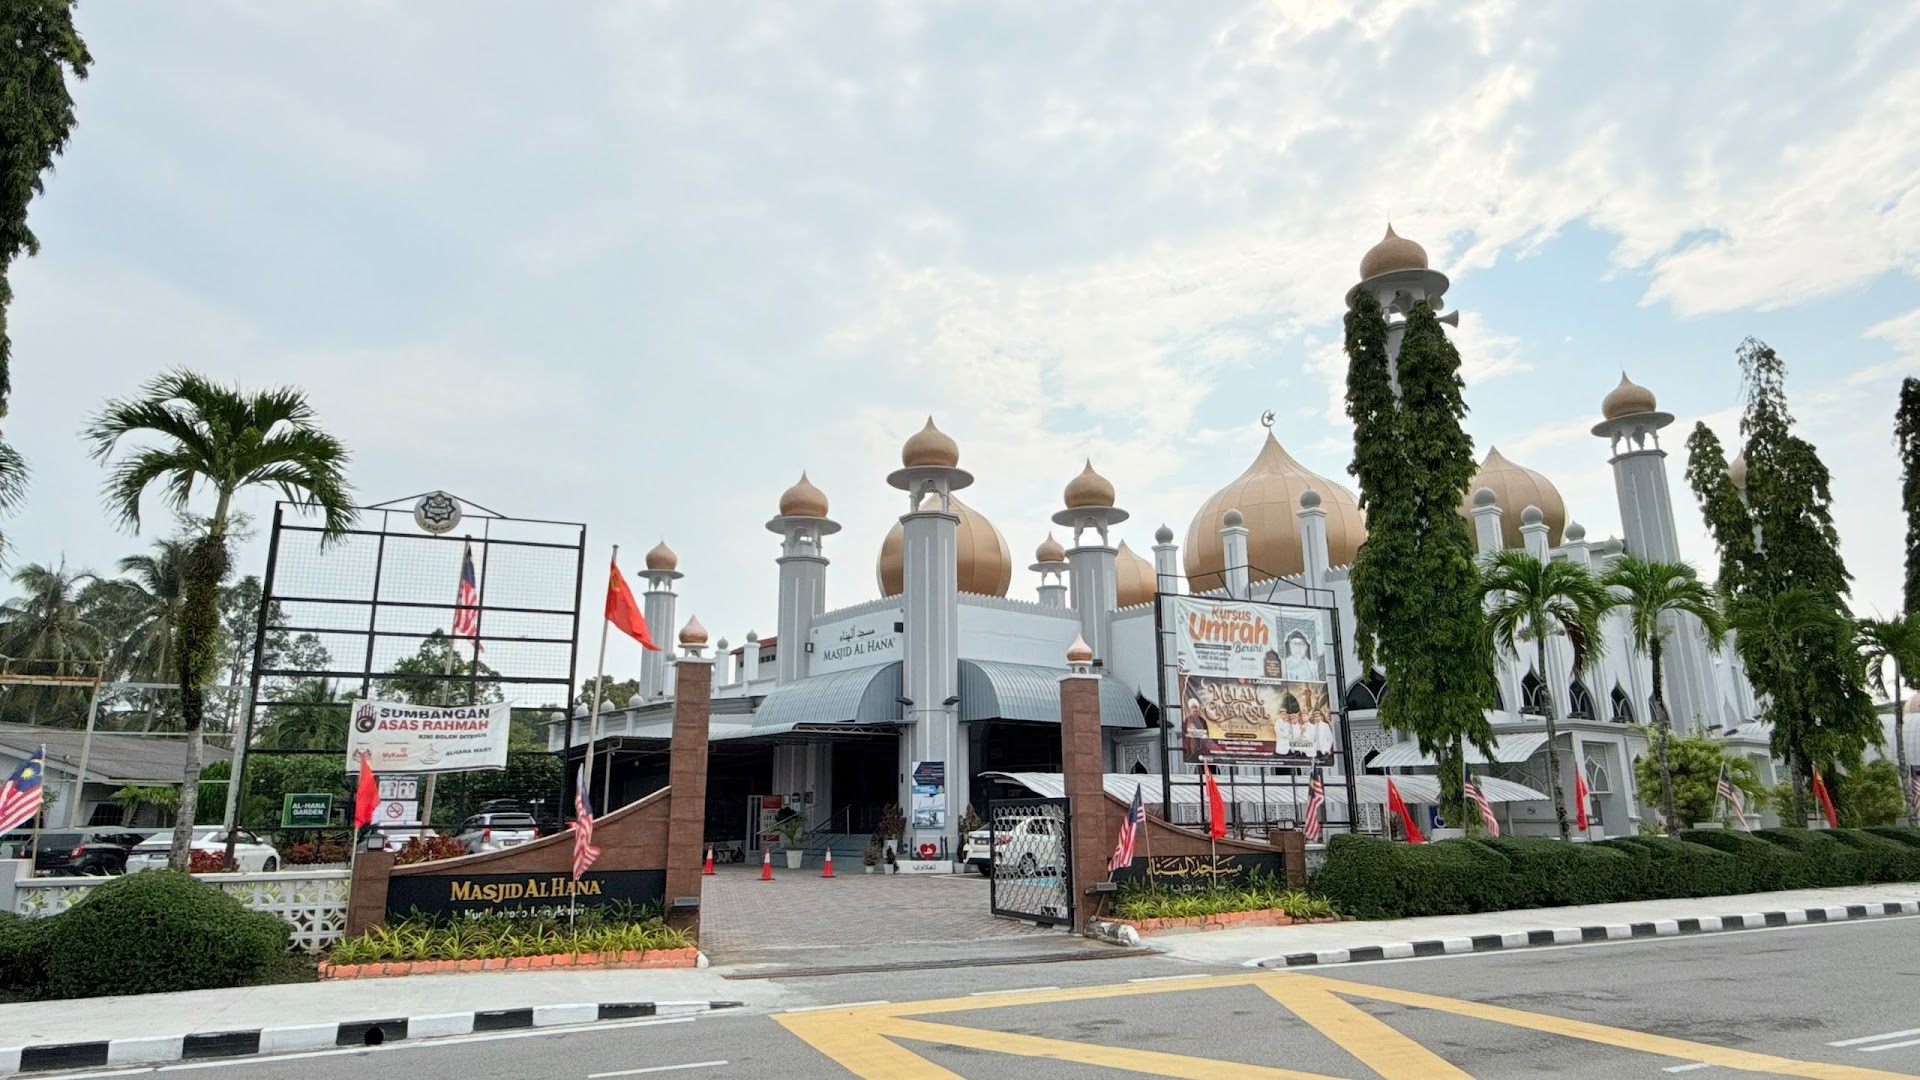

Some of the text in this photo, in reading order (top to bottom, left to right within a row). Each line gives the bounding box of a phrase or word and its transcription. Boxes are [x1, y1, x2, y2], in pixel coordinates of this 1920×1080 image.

[1212, 606, 1251, 621] Kursus
[1189, 612, 1269, 645] Umrah
[823, 646, 852, 661] MASJID
[854, 644, 864, 655] AL
[380, 708, 490, 719] SUMBANGAN
[378, 720, 489, 730] ASAS RAHMAH
[450, 881, 523, 903] MASJID
[524, 879, 549, 898] AL
